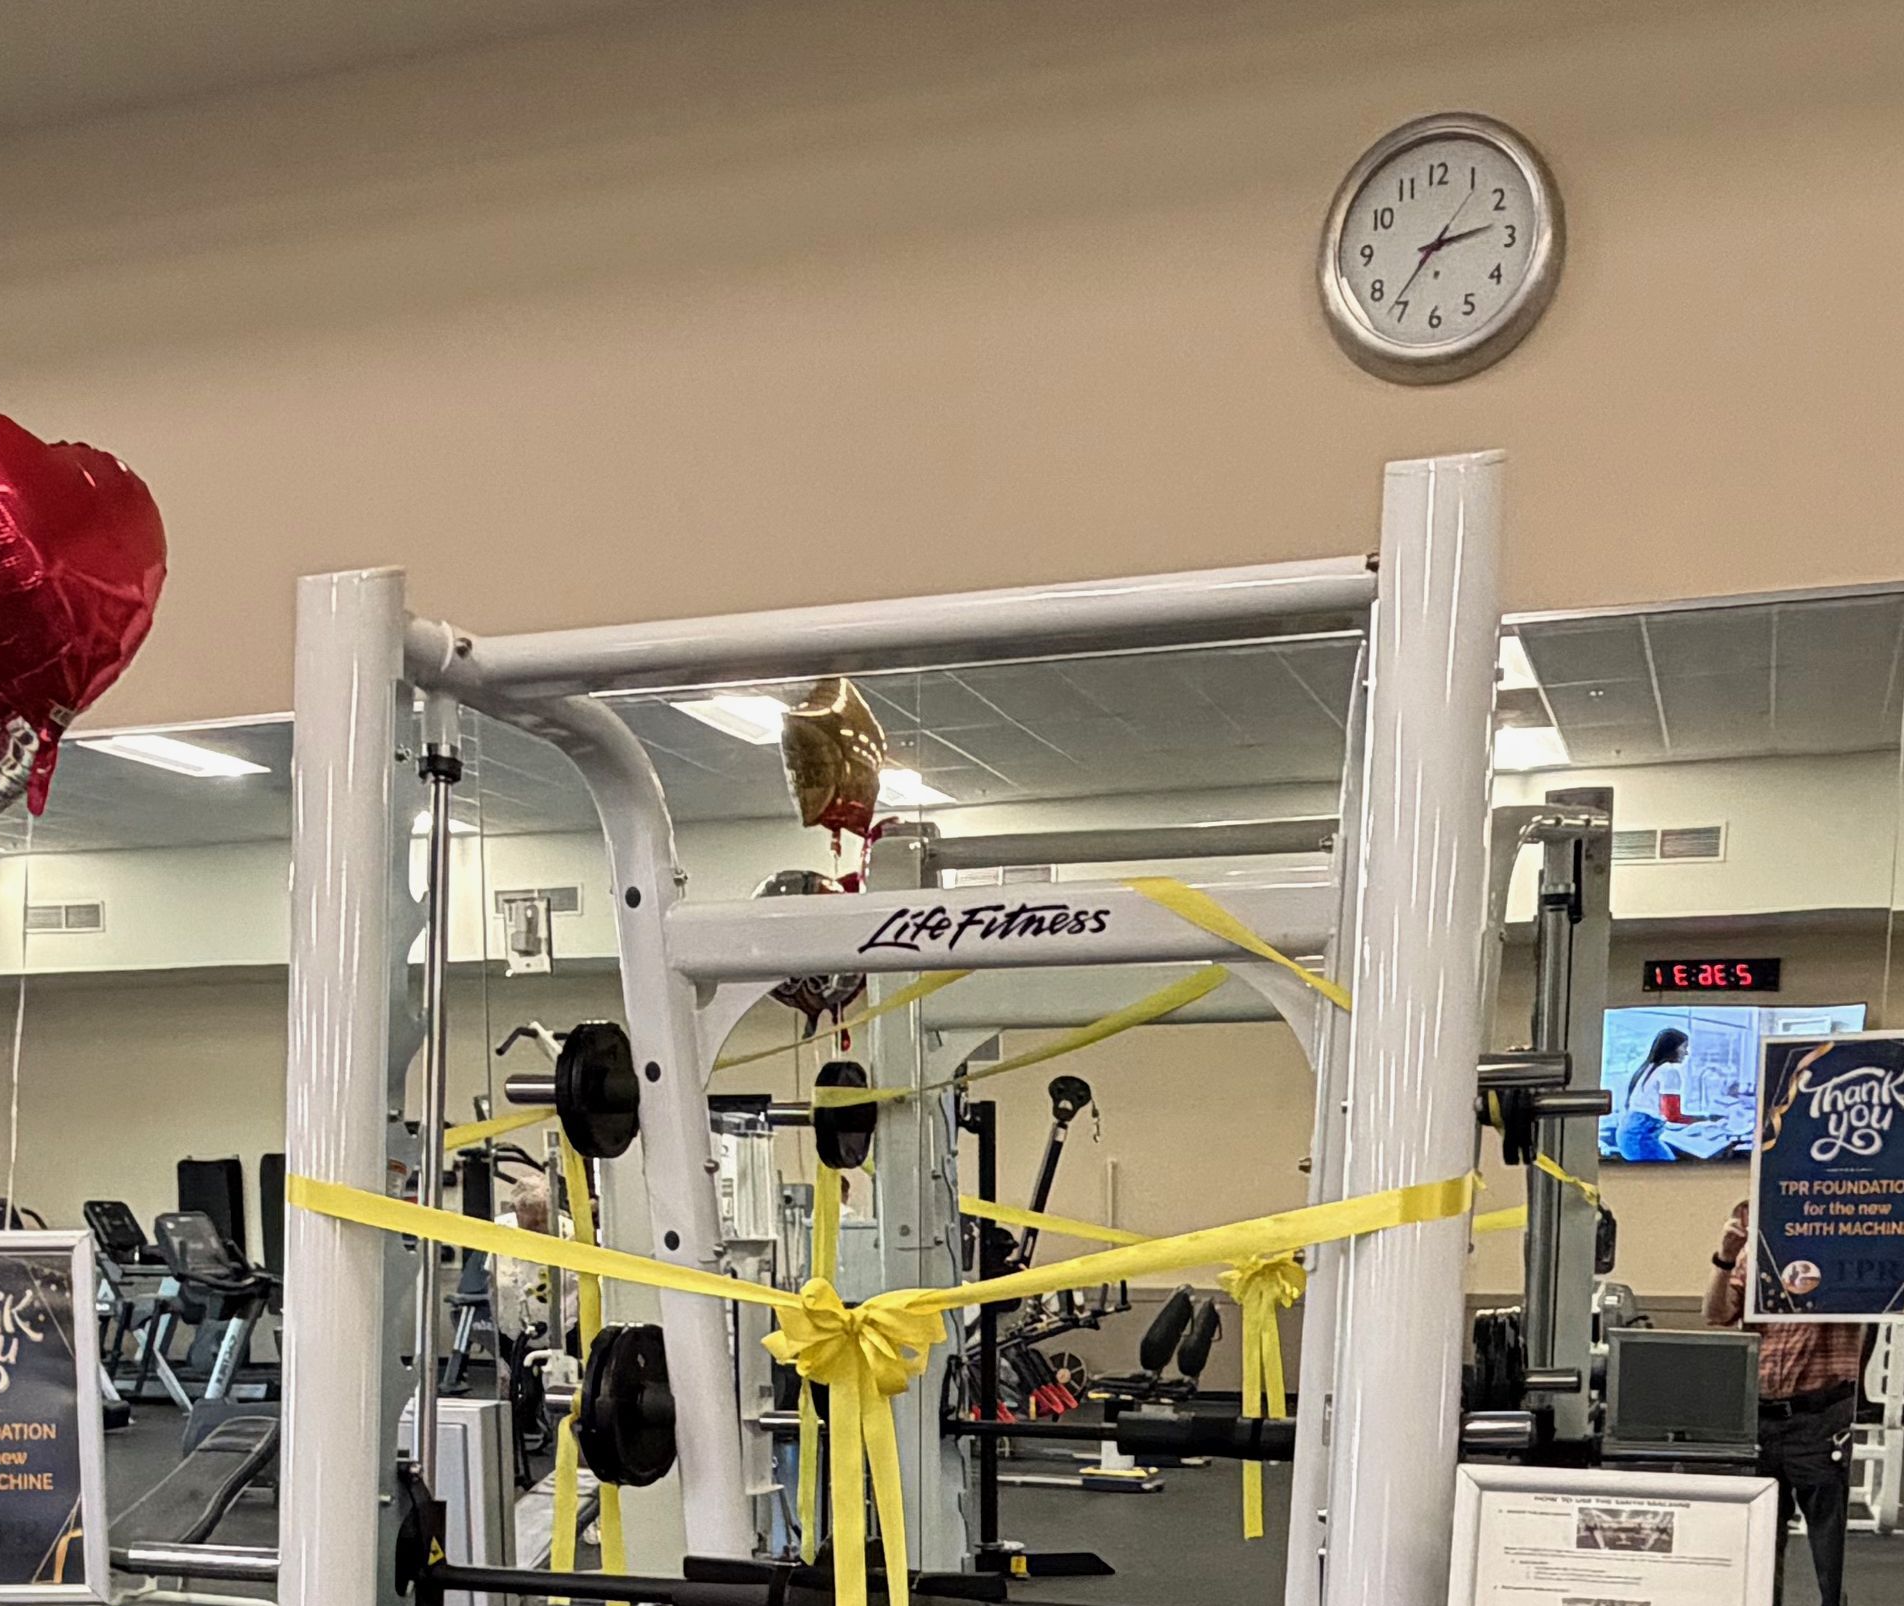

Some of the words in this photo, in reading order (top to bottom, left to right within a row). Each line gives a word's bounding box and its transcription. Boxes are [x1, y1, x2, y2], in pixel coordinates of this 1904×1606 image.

[1428, 162, 1449, 188] 12
[1470, 166, 1476, 190] 1
[1397, 178, 1416, 202] 11
[1491, 188, 1507, 211] 2
[1372, 207, 1395, 231] 10
[1503, 225, 1517, 248] 3
[1359, 244, 1374, 267] 9
[1488, 262, 1503, 285] 4
[1369, 279, 1385, 302] 8
[1394, 299, 1410, 323] 7
[1461, 293, 1477, 316] 5
[1428, 305, 1443, 328] 6
[857, 906, 952, 955] Life
[948, 903, 1111, 951] Fitness
[1779, 1180, 1809, 1196] TPR
[1803, 1201, 1824, 1215] for
[1829, 1201, 1855, 1215] the
[1858, 1203, 1892, 1215] new
[1784, 1221, 1836, 1236] SMITH
